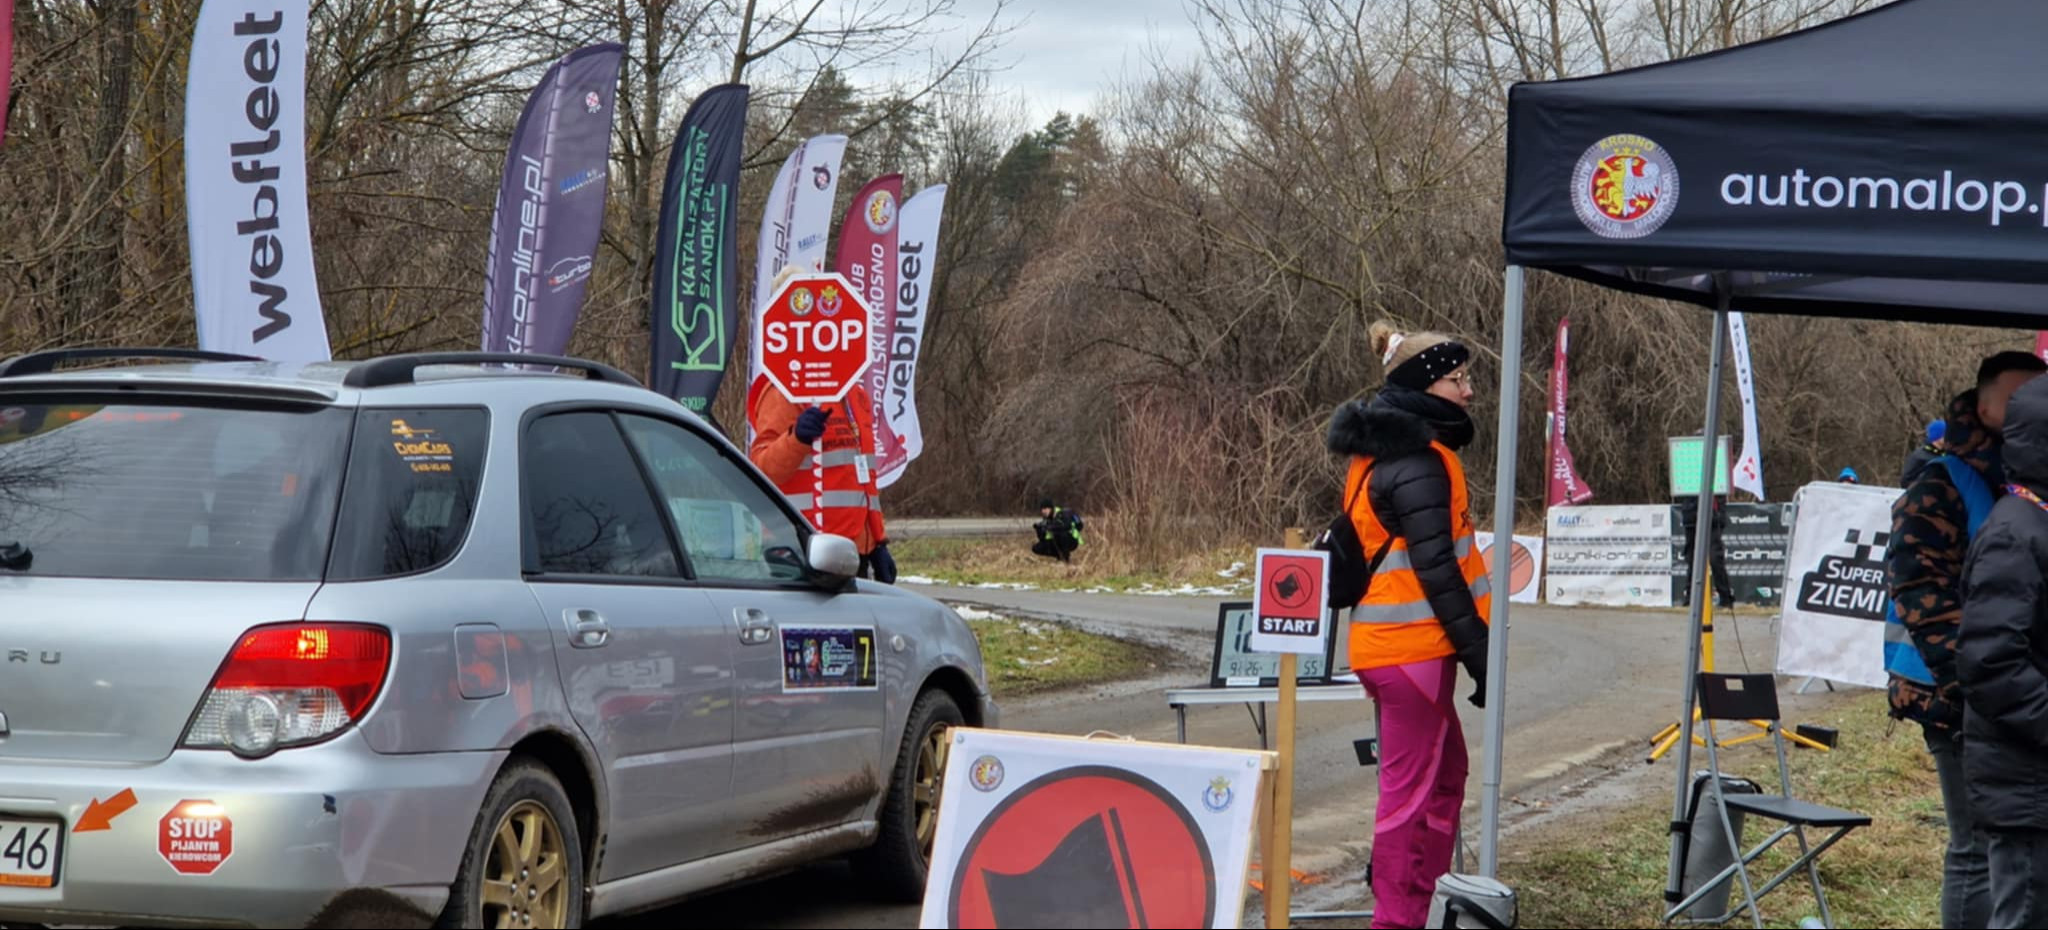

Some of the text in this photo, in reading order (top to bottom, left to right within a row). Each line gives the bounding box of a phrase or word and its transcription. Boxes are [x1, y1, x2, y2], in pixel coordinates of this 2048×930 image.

[230, 11, 292, 344] webfleet
[1720, 168, 2048, 228] automalop.
[700, 182, 718, 298] SANOK.PL
[503, 154, 545, 369] ki-online.pl
[870, 243, 885, 328] KROSNO
[766, 320, 864, 353] STOP
[891, 241, 924, 422] webfleet
[1553, 550, 1669, 563] wyniki-online.pl
[1826, 559, 1884, 584] SUPER
[1807, 581, 1886, 614] ZIEMI
[1263, 617, 1315, 633] START
[860, 637, 870, 679] 7
[0, 826, 50, 870] 46
[168, 817, 222, 839] STOP
[171, 840, 219, 851] PIJANYM
